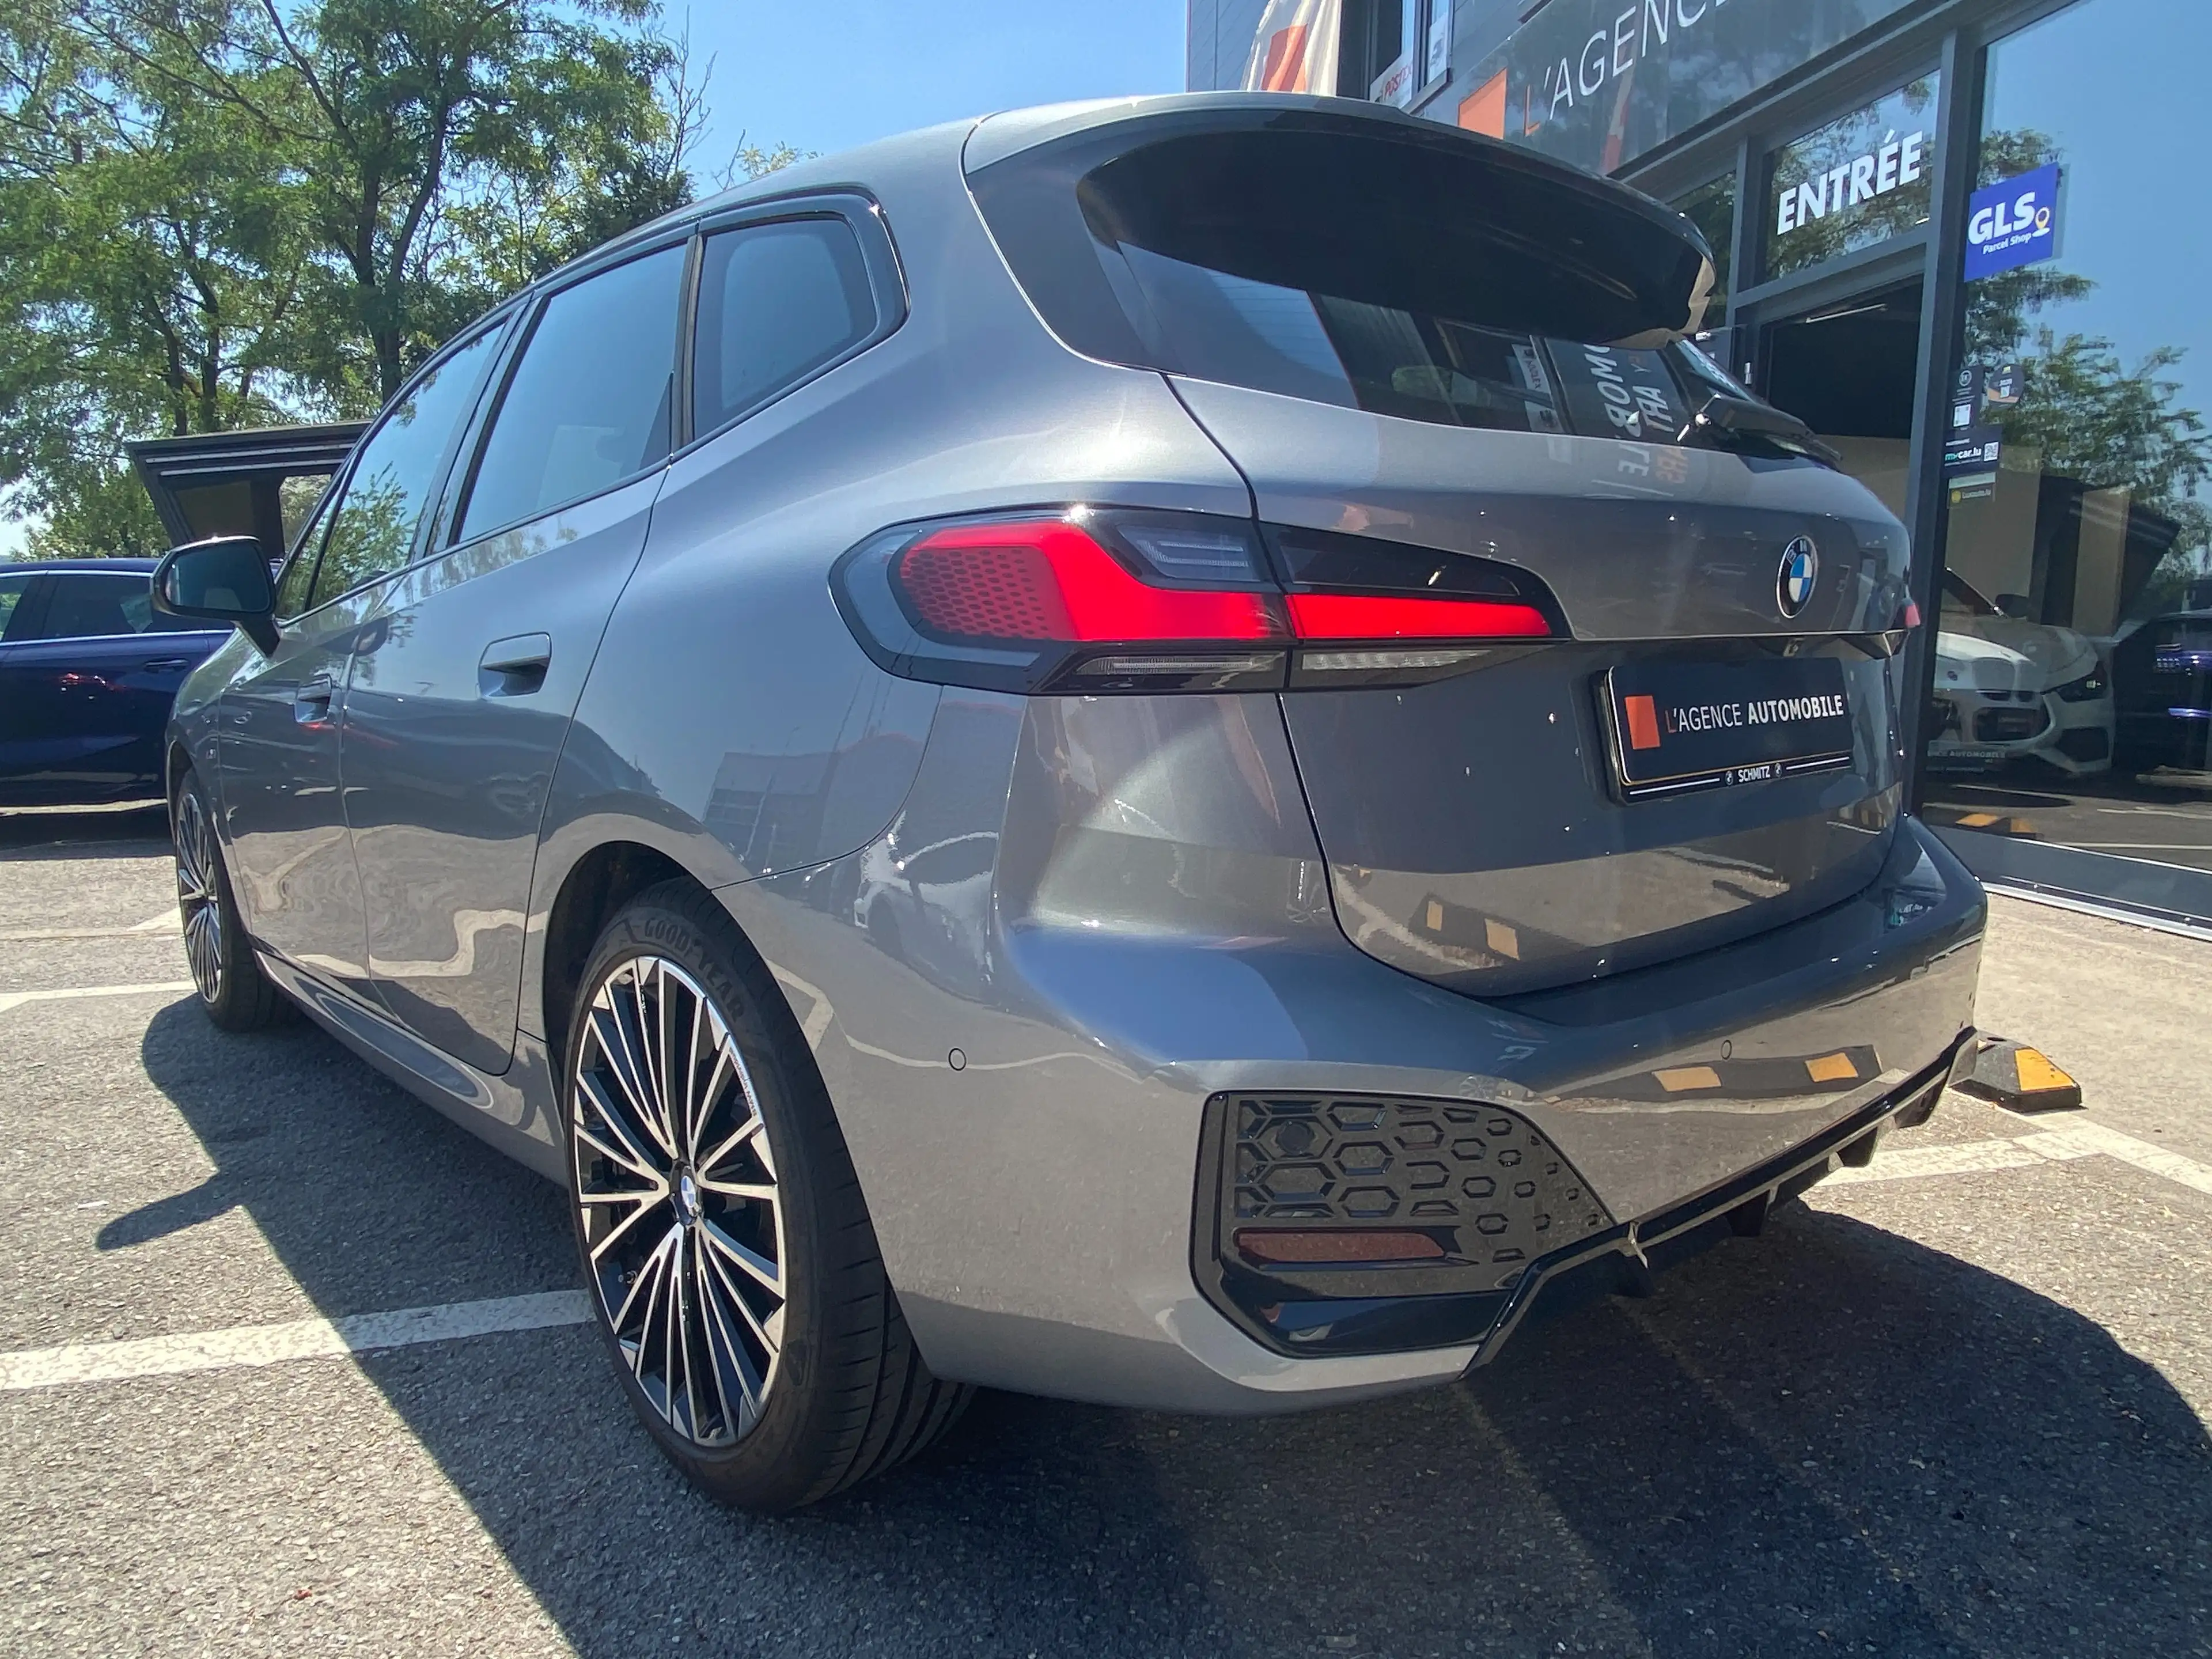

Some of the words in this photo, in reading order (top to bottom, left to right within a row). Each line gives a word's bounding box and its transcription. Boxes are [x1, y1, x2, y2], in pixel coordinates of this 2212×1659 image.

[1524, 0, 1728, 137] L'AGEN
[1777, 130, 1923, 236] ENTRÉE
[1968, 191, 2036, 245] GLS
[1983, 239, 2009, 255] Parcel
[2010, 232, 2032, 248] Shop
[1664, 703, 1743, 733] L'AGENCE
[1748, 694, 1844, 725] AUTOMOBILE
[1738, 766, 1771, 783] SCHMITZ
[645, 918, 745, 1024] GOODYEAR
